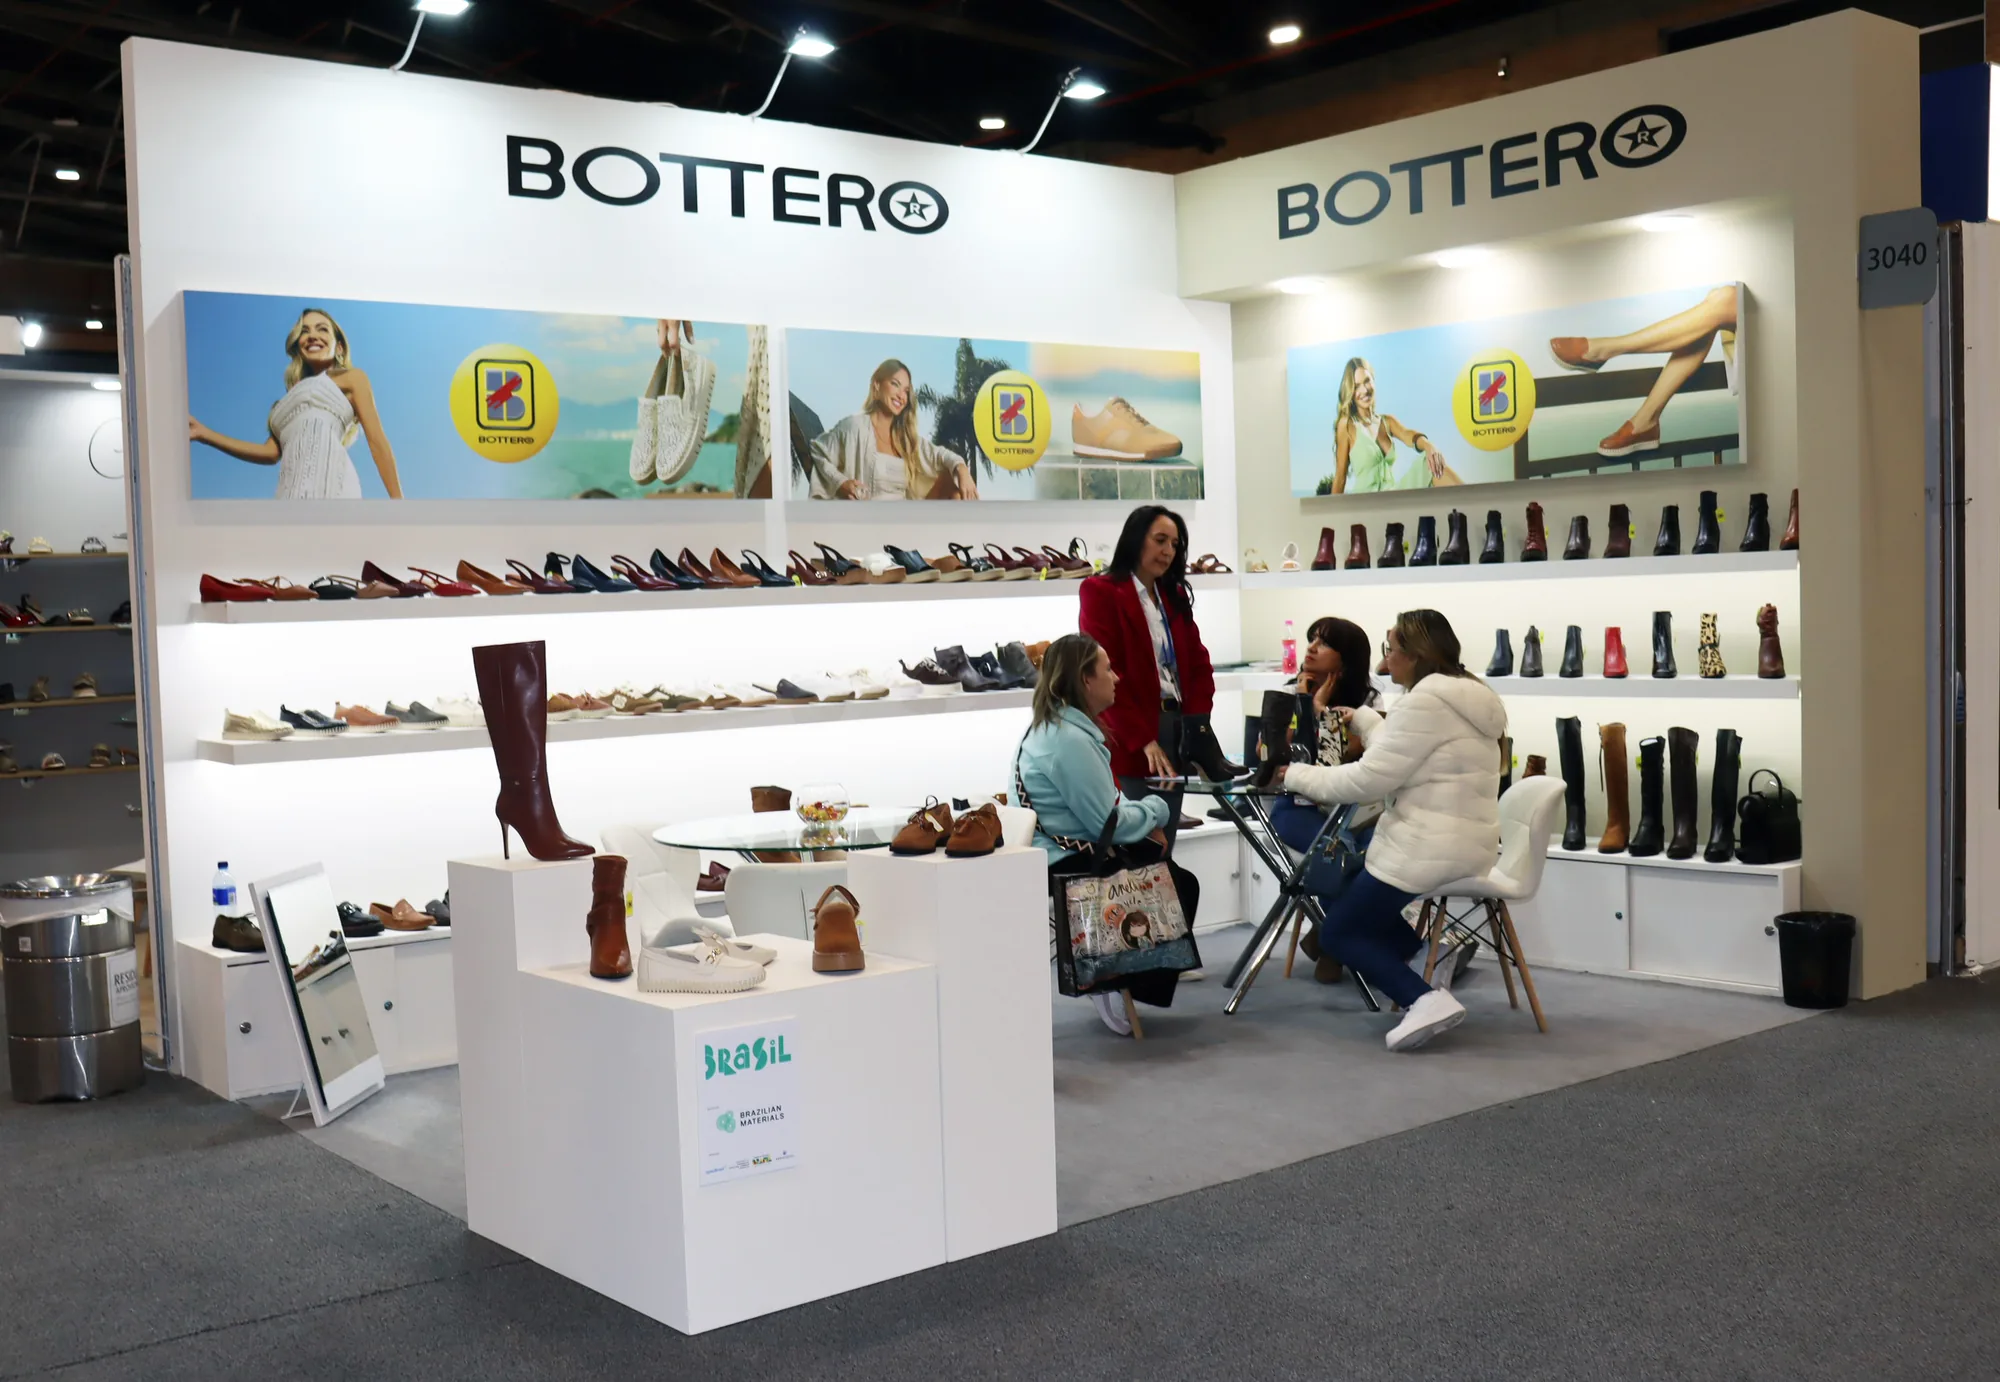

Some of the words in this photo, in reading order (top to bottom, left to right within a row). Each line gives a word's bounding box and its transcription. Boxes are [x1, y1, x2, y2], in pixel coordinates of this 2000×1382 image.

[506, 134, 949, 235] BOTTERO
[1277, 104, 1687, 239] BOTTERO
[1867, 242, 1927, 271] 3040
[740, 1105, 782, 1119] BRAZILIAN
[740, 1113, 785, 1127] MATERIALS
